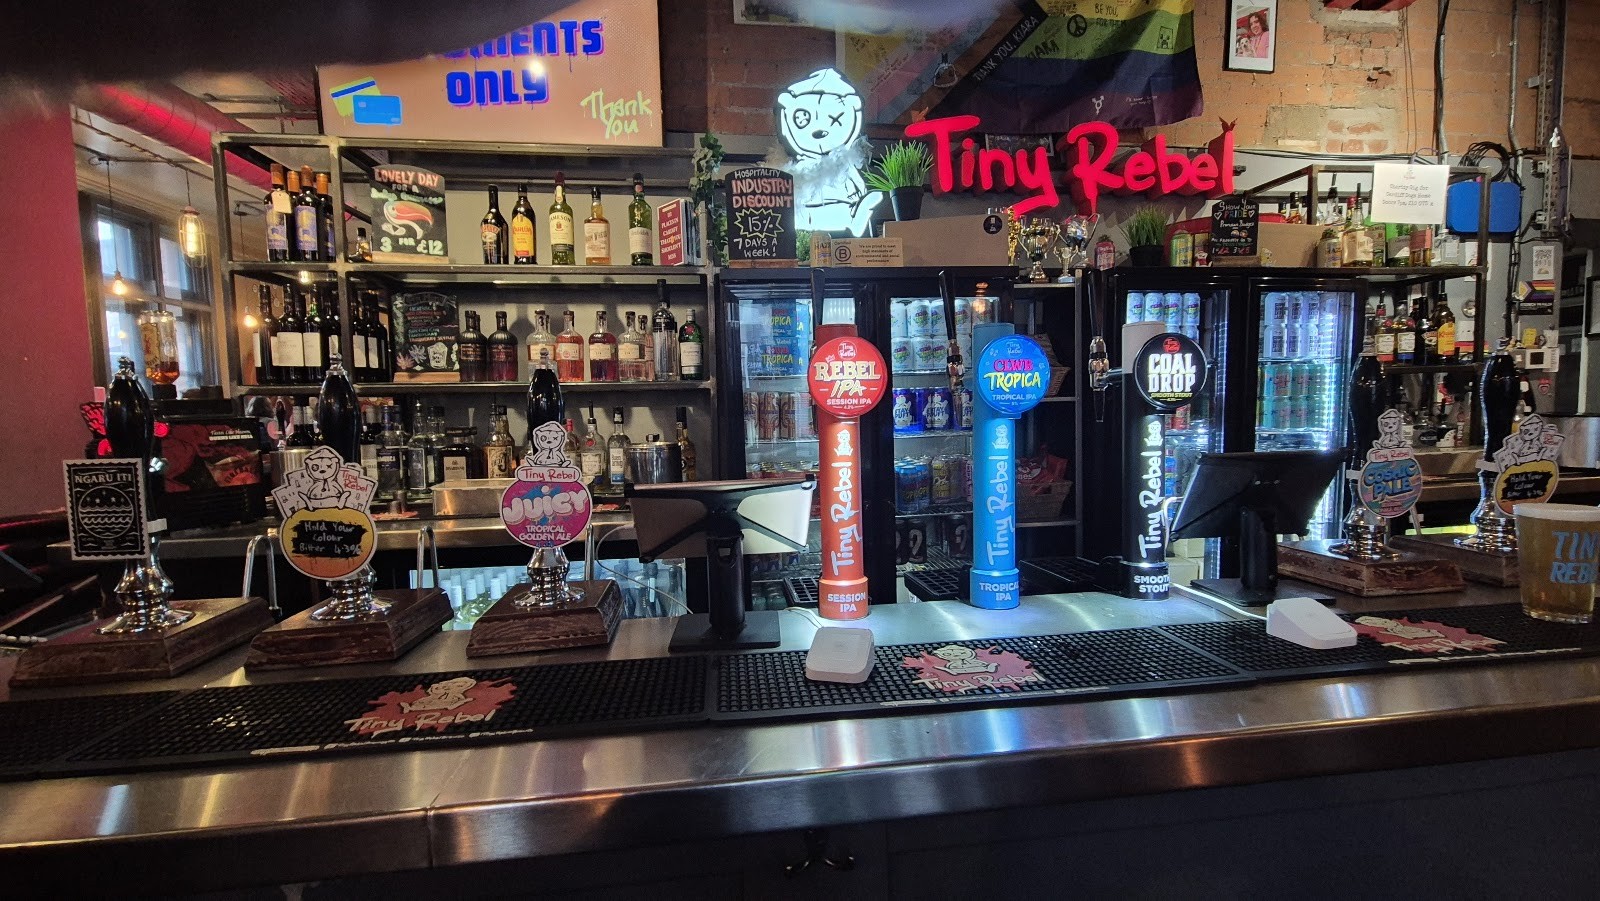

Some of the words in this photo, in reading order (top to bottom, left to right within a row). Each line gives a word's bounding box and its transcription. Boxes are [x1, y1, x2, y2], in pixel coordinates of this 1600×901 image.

[446, 69, 550, 106] ONLY
[580, 88, 653, 127] Thank
[602, 115, 639, 140] You
[734, 169, 781, 179] HOSPITALITY
[904, 115, 1059, 217] Tiny
[1066, 120, 1235, 216] Rebel
[375, 168, 416, 185] LOVELY
[417, 173, 438, 188] DAY
[731, 177, 793, 195] INDUSTRY
[732, 195, 793, 208] DISCOUNT
[1224, 210, 1248, 219] PRIDE
[748, 216, 774, 233] 15%
[380, 236, 393, 252] 3
[734, 238, 744, 250] 7
[745, 237, 768, 248] DAYS
[771, 238, 778, 246] A
[839, 248, 848, 259] B
[993, 358, 1034, 373] CLWB
[1148, 352, 1197, 374] COAL
[814, 361, 881, 382] REBEL
[830, 379, 867, 398] IPA
[983, 371, 1041, 392] TROPICA
[1147, 372, 1196, 393] DROP
[826, 398, 859, 406] SESSION
[991, 393, 1025, 401] TROPICAL
[74, 474, 114, 484] NGARU
[116, 473, 132, 482] ITI
[341, 469, 359, 482] Tiny
[520, 468, 546, 481] Tiny
[547, 468, 576, 481] Rebel
[1138, 450, 1166, 509] Rebel
[343, 480, 369, 492] Rebel
[831, 461, 860, 523] Rebel
[986, 455, 1014, 514] Rebel
[1373, 477, 1414, 500] PALE
[304, 521, 328, 532] Hold
[332, 522, 355, 533] Your
[525, 525, 566, 533] TROPICAL
[1138, 508, 1167, 559] Tiny
[312, 532, 344, 542] Colour
[518, 532, 556, 541] GOLDEN
[556, 532, 572, 540] ALE
[986, 514, 1016, 566] Tiny
[831, 523, 863, 576] Tiny
[1139, 583, 1169, 593] STOUT
[827, 593, 866, 603] SESSION
[995, 592, 1012, 601] IPA
[840, 603, 857, 613] IPA
[912, 677, 978, 695] Tiny
[972, 671, 1047, 690] Rebel
[343, 716, 405, 740] Tiny
[414, 708, 497, 732] Rebel
